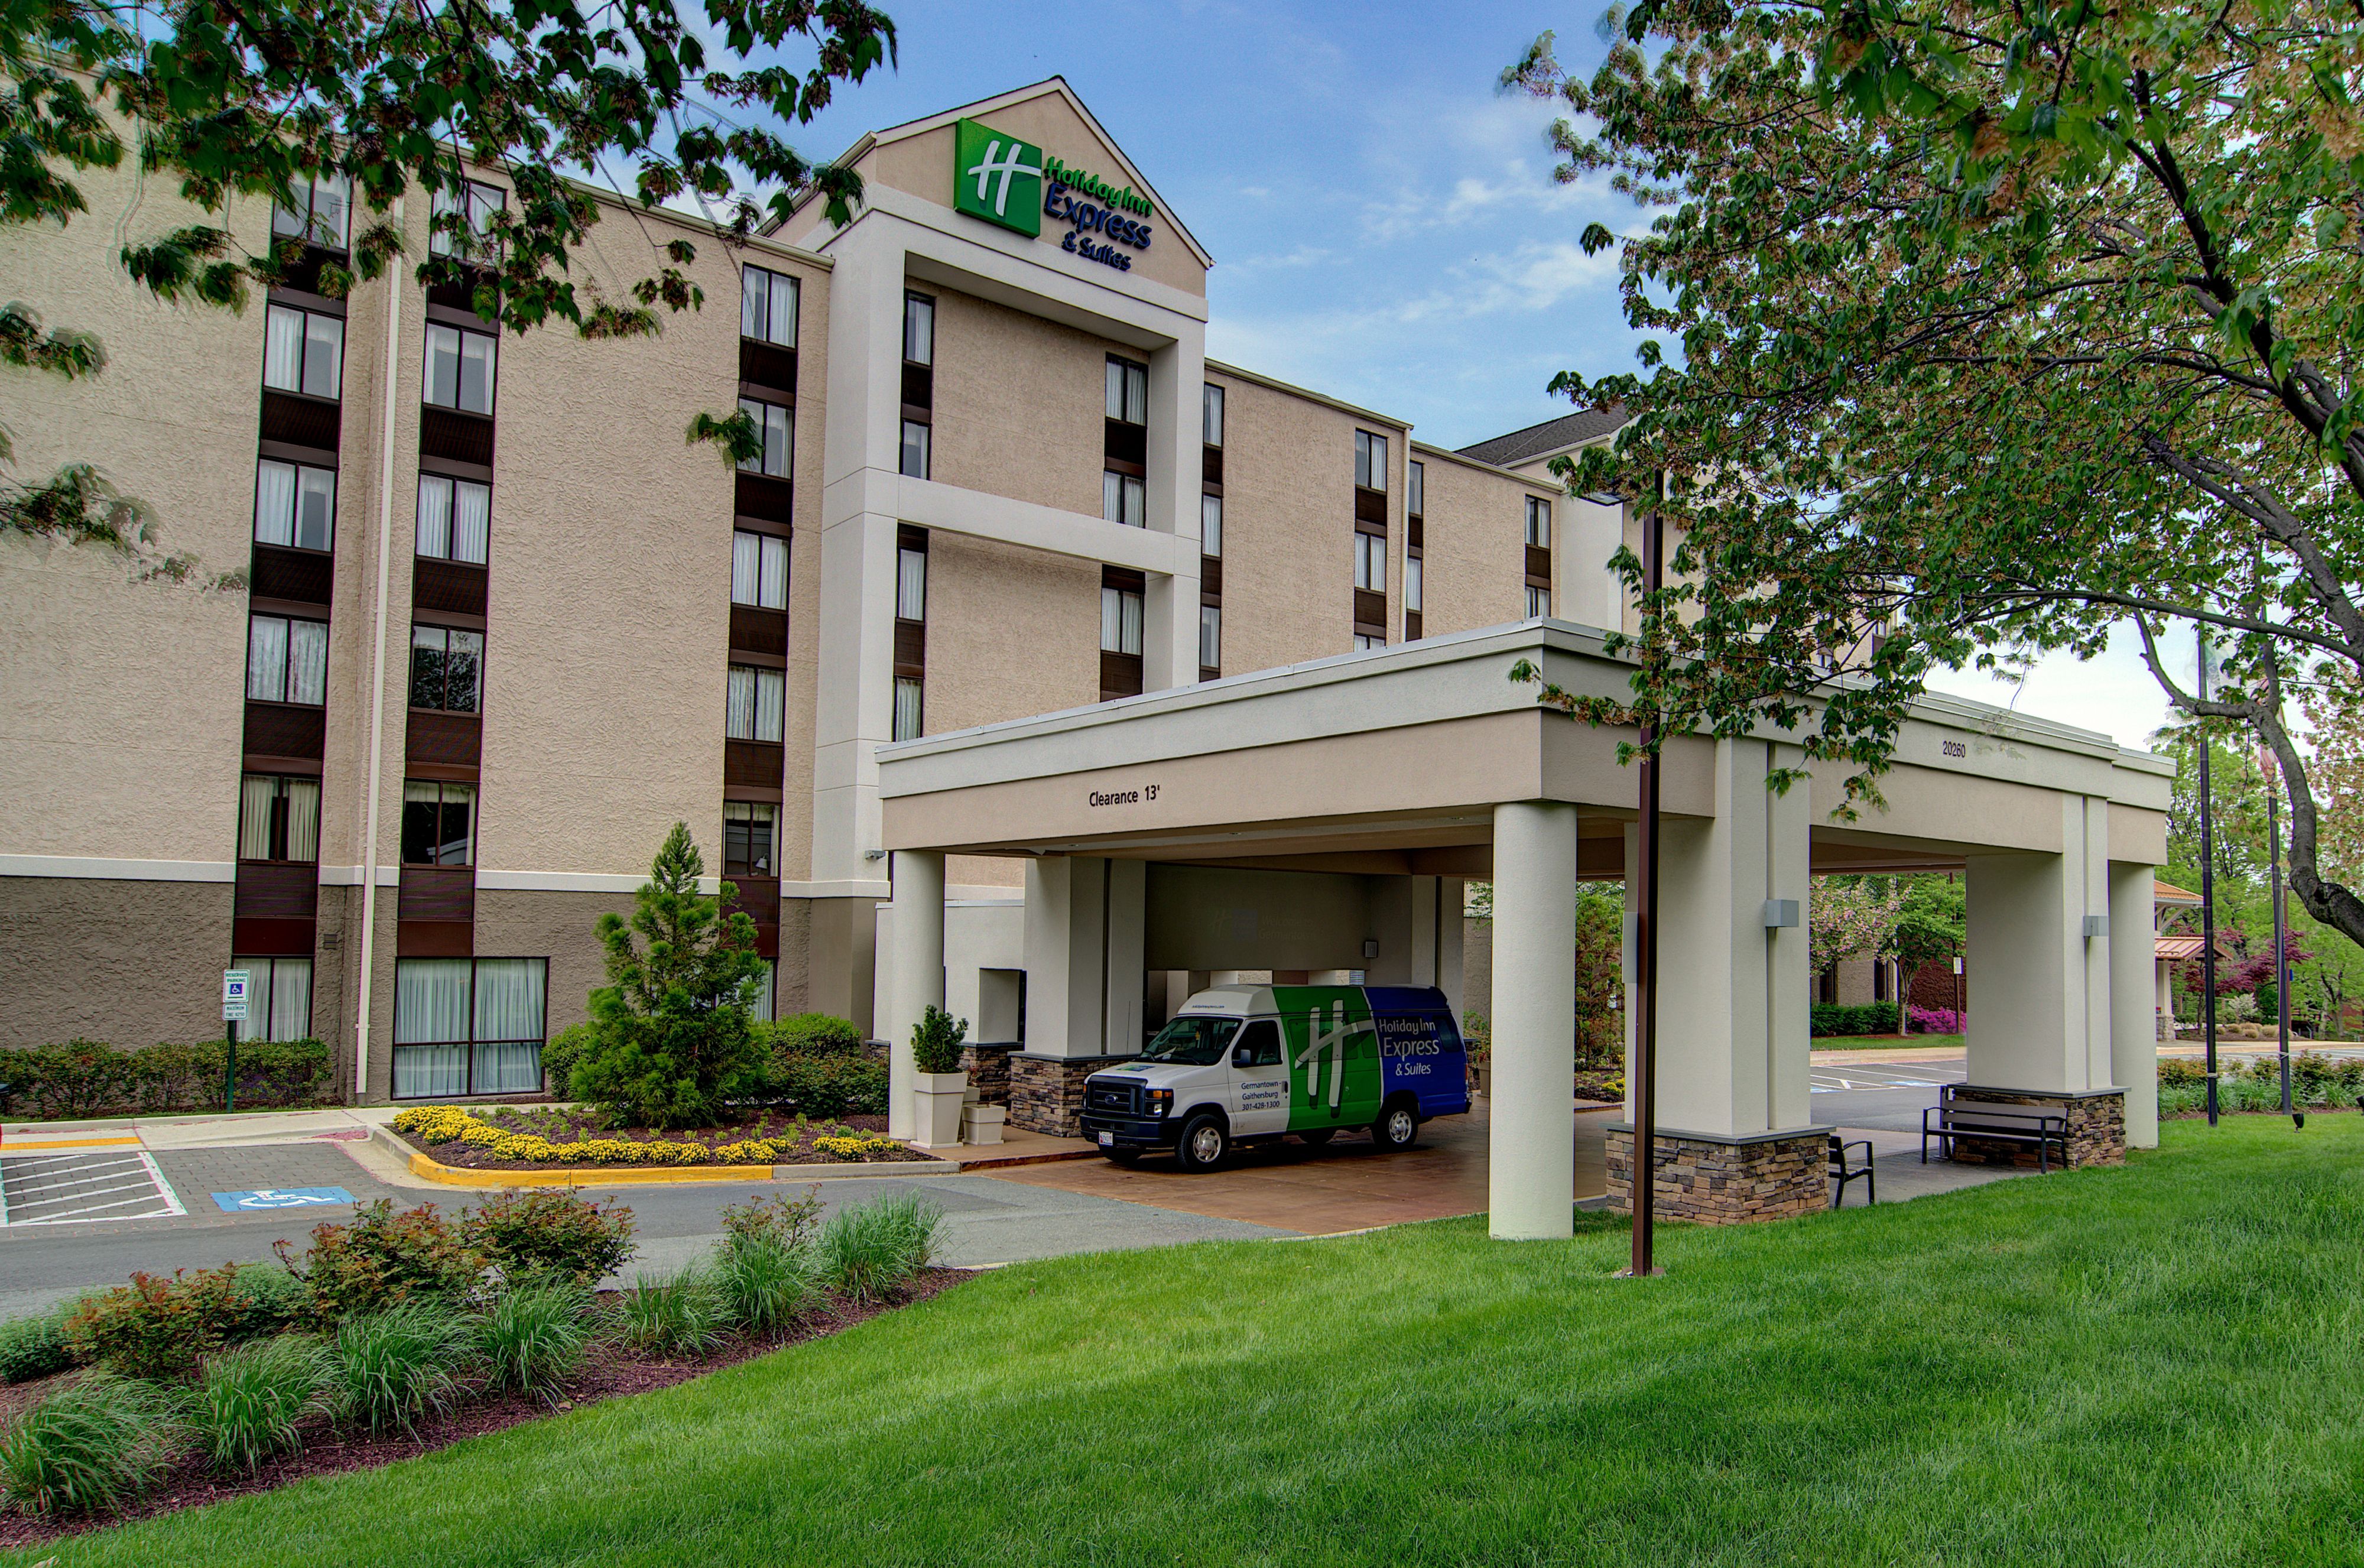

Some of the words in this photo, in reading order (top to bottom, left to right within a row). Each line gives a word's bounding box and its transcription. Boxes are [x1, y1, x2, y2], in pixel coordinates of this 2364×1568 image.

[1044, 156, 1122, 209] Holiday
[1121, 186, 1153, 217] Inn
[1044, 183, 1152, 249] Express
[1061, 231, 1077, 253] &
[1077, 237, 1131, 271] Suites
[1943, 741, 1966, 758] 20260
[1089, 791, 1138, 807] Clearance
[1145, 784, 1160, 800] 13'
[1378, 1018, 1418, 1035] Holiday
[1420, 1018, 1436, 1031] Inn
[1384, 1037, 1440, 1061] Express
[1395, 1063, 1402, 1076] &
[1404, 1063, 1431, 1076] Suites
[1241, 1081, 1278, 1089] Germantown
[1242, 1091, 1278, 1100] Gaithersburg
[1242, 1100, 1280, 1111] 301-428-1300
